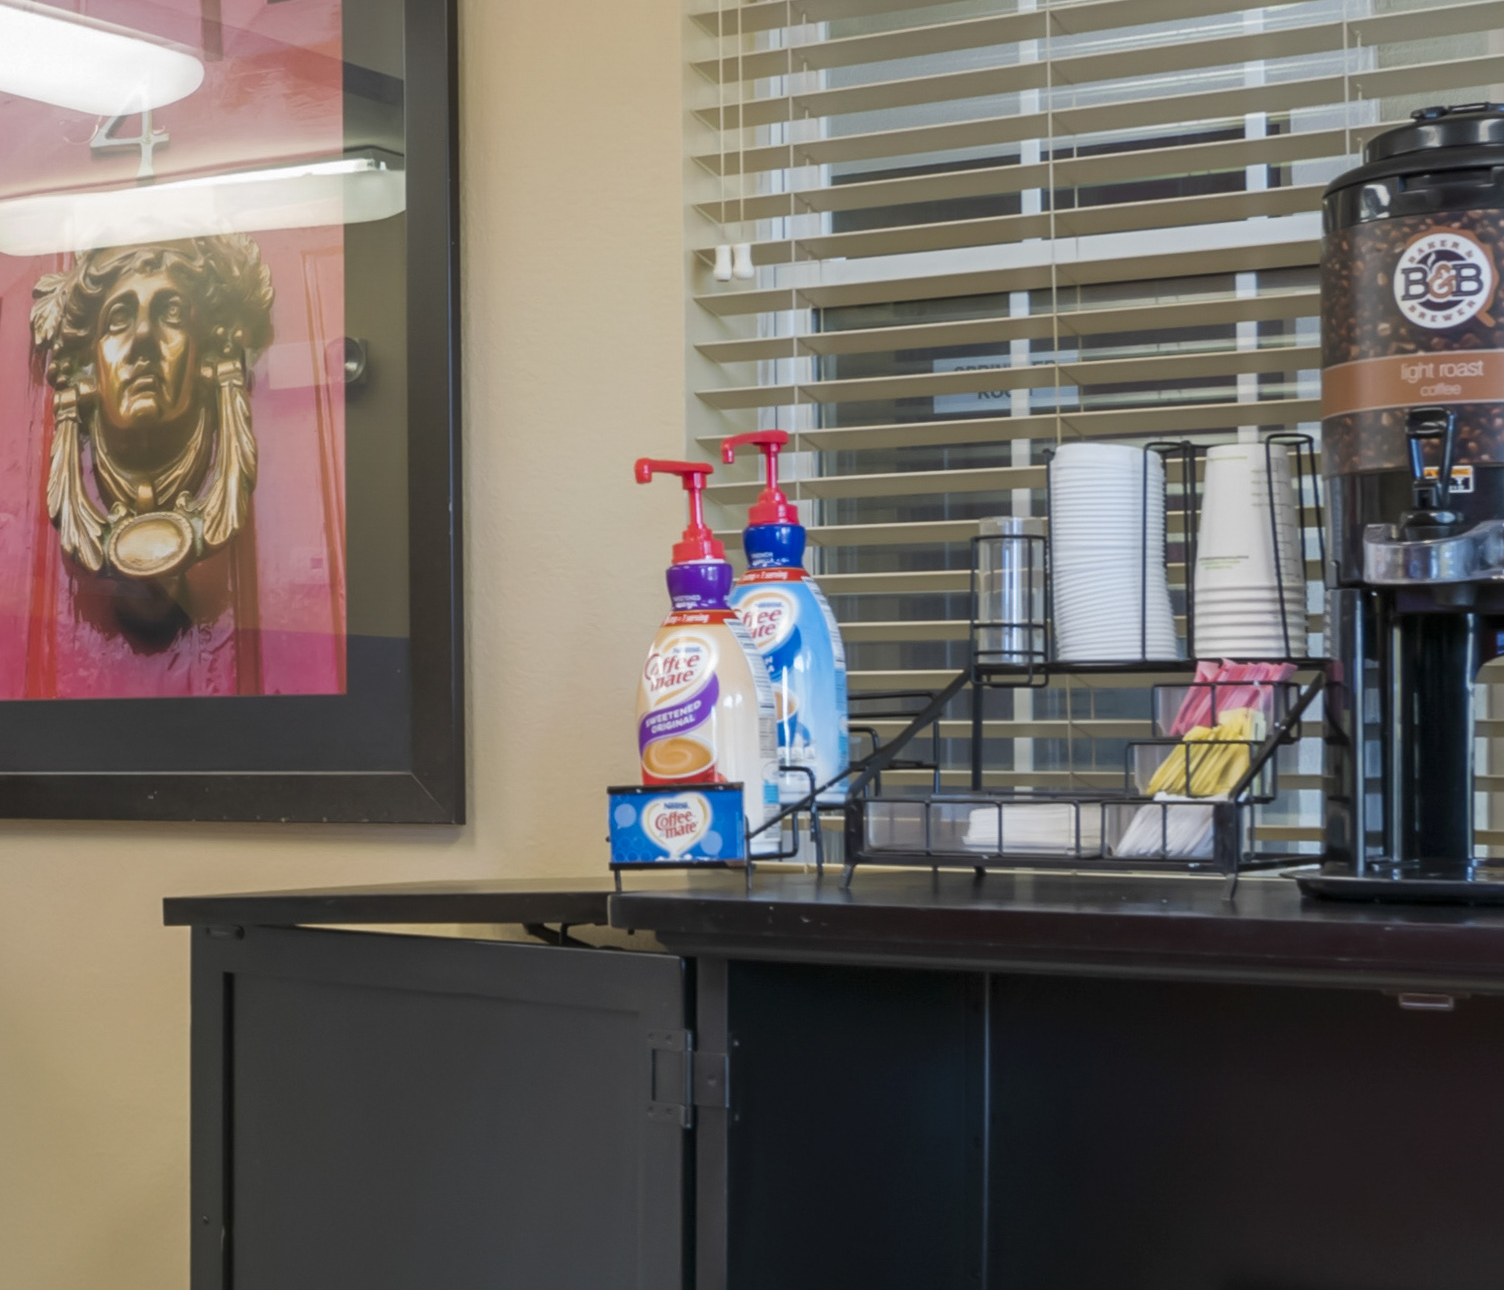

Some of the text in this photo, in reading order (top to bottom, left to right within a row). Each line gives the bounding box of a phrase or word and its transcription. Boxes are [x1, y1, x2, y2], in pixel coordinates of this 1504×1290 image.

[1408, 240, 1461, 263] BAKER
[1401, 262, 1484, 302] B&B
[1408, 300, 1476, 323] BREWER
[1400, 360, 1484, 384] light roast
[1420, 383, 1462, 397] coffee
[645, 700, 702, 728] SWEETENED
[651, 714, 696, 734] ORIGINAL
[665, 822, 697, 839] mate
